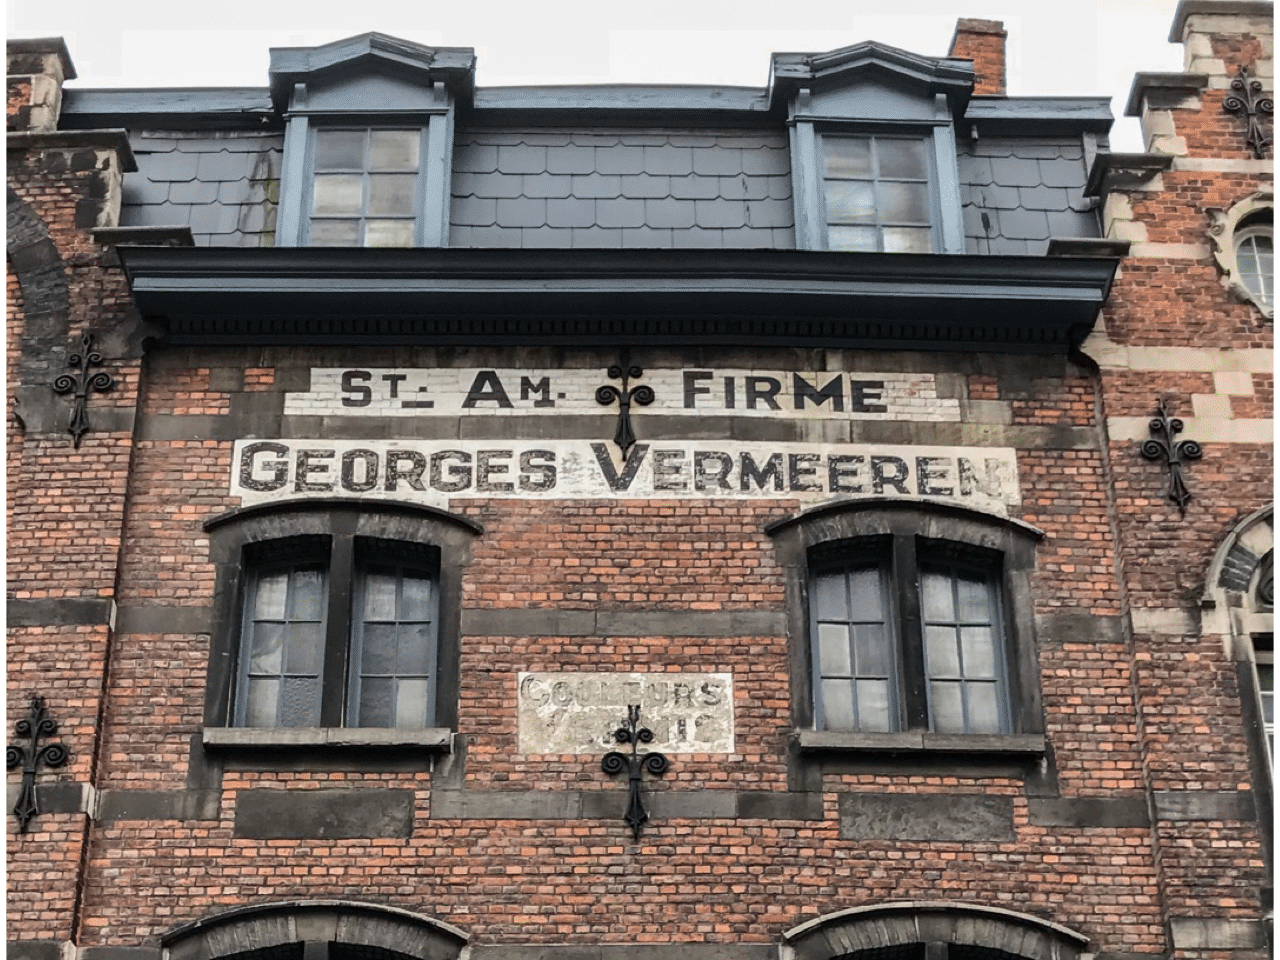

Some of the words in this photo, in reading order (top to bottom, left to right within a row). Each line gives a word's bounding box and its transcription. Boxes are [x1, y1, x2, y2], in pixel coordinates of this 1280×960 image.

[682, 371, 888, 413] FIRME
[239, 442, 556, 492] GEORGES
[590, 443, 1002, 496] VERMEEREN
